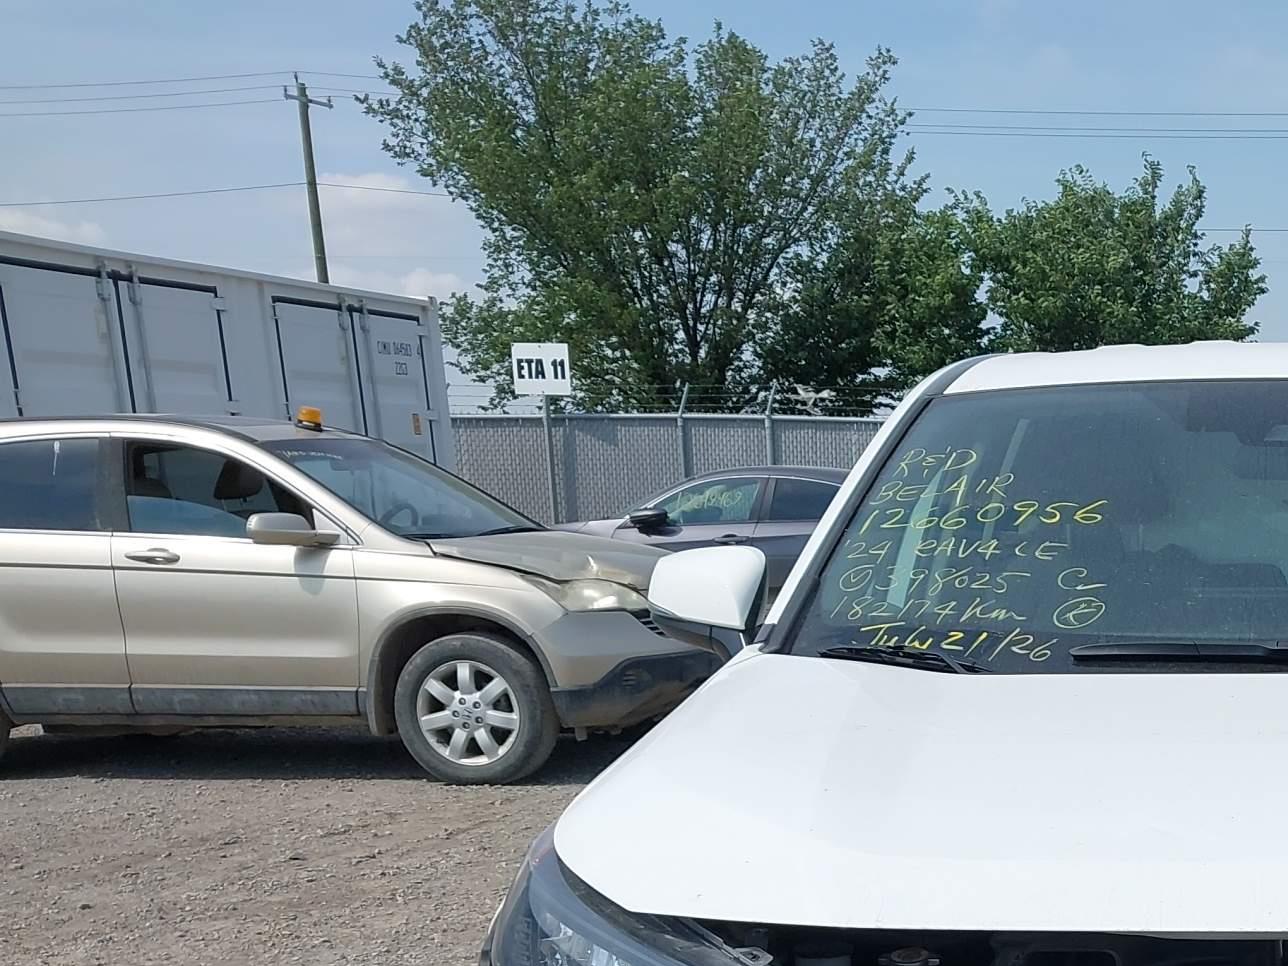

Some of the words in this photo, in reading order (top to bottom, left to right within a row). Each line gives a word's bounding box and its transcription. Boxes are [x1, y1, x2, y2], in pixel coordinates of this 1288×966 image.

[516, 358, 546, 380] ETA
[551, 358, 566, 380] 11
[859, 500, 1109, 535] 12660956
